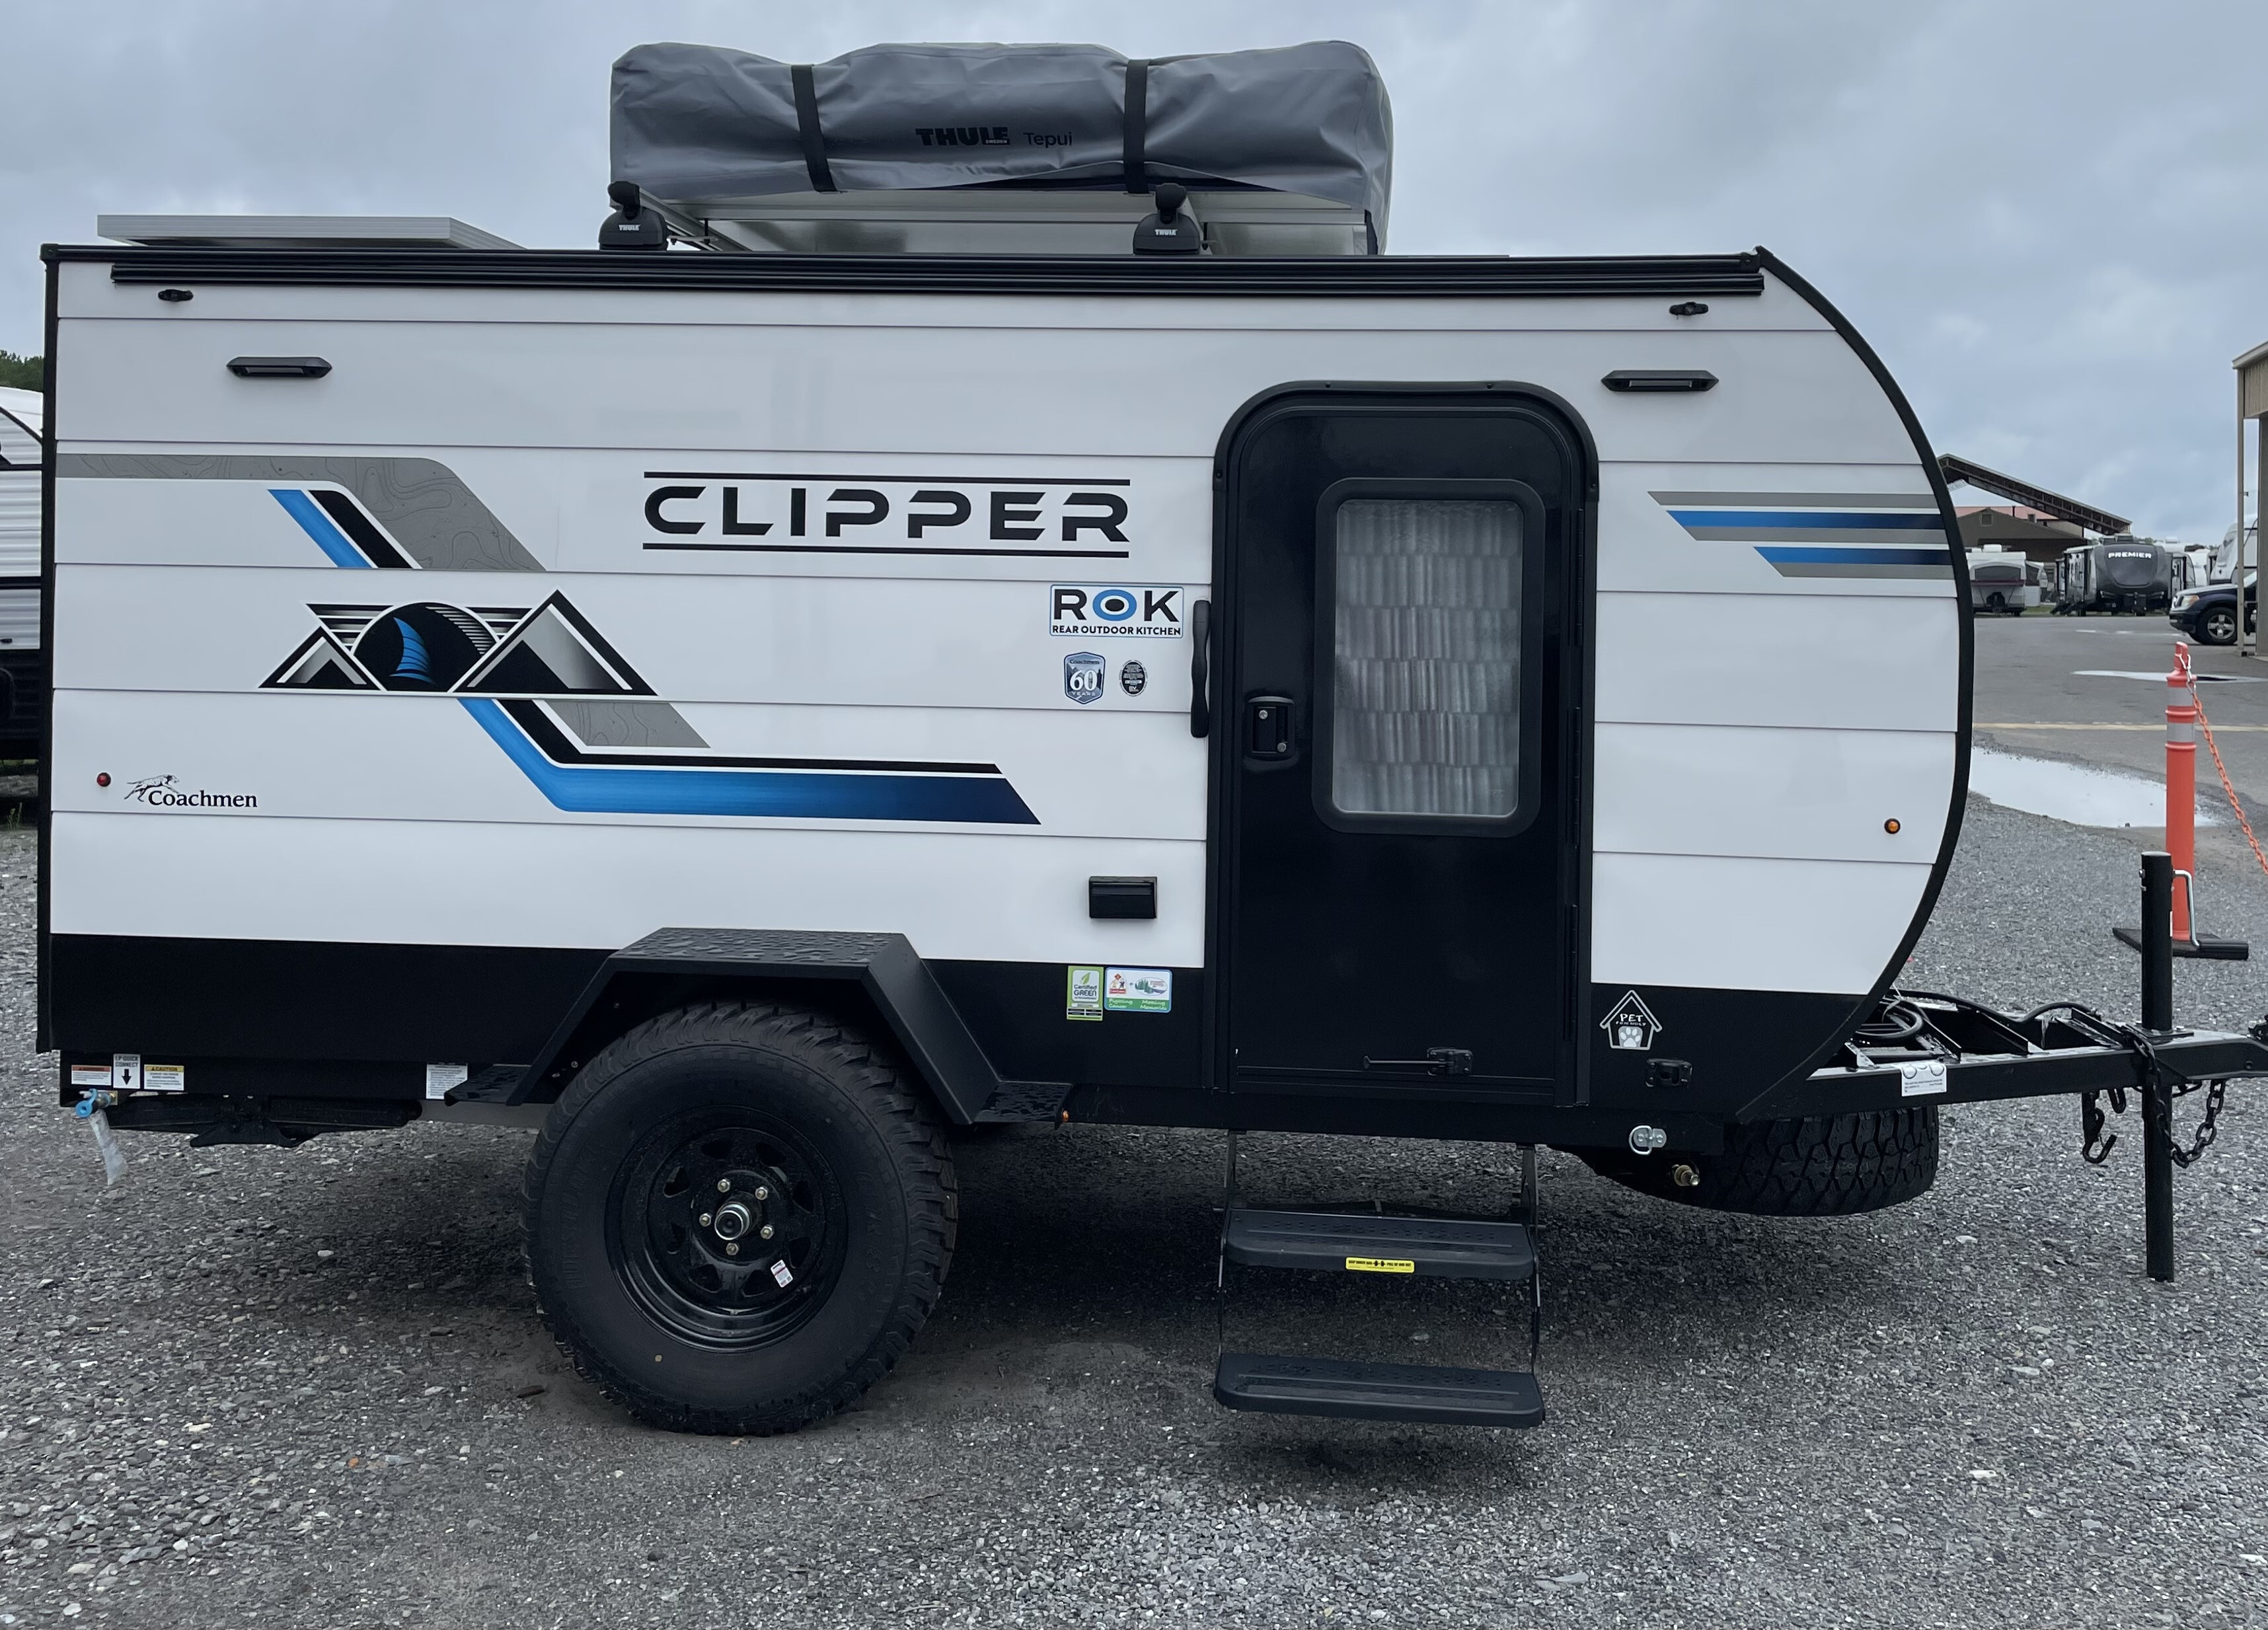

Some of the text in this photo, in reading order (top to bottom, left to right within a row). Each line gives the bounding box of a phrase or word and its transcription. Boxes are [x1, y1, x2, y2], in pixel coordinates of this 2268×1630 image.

[915, 127, 1073, 149] THULE Tepui
[644, 486, 1131, 542] CLIPPER
[1053, 589, 1180, 622] ROK
[1052, 625, 1181, 636] REAR OUTDOOR KITCHEN
[1069, 669, 1098, 691] 60
[148, 790, 258, 808] Coachmen
[1620, 1013, 1644, 1022] PET
